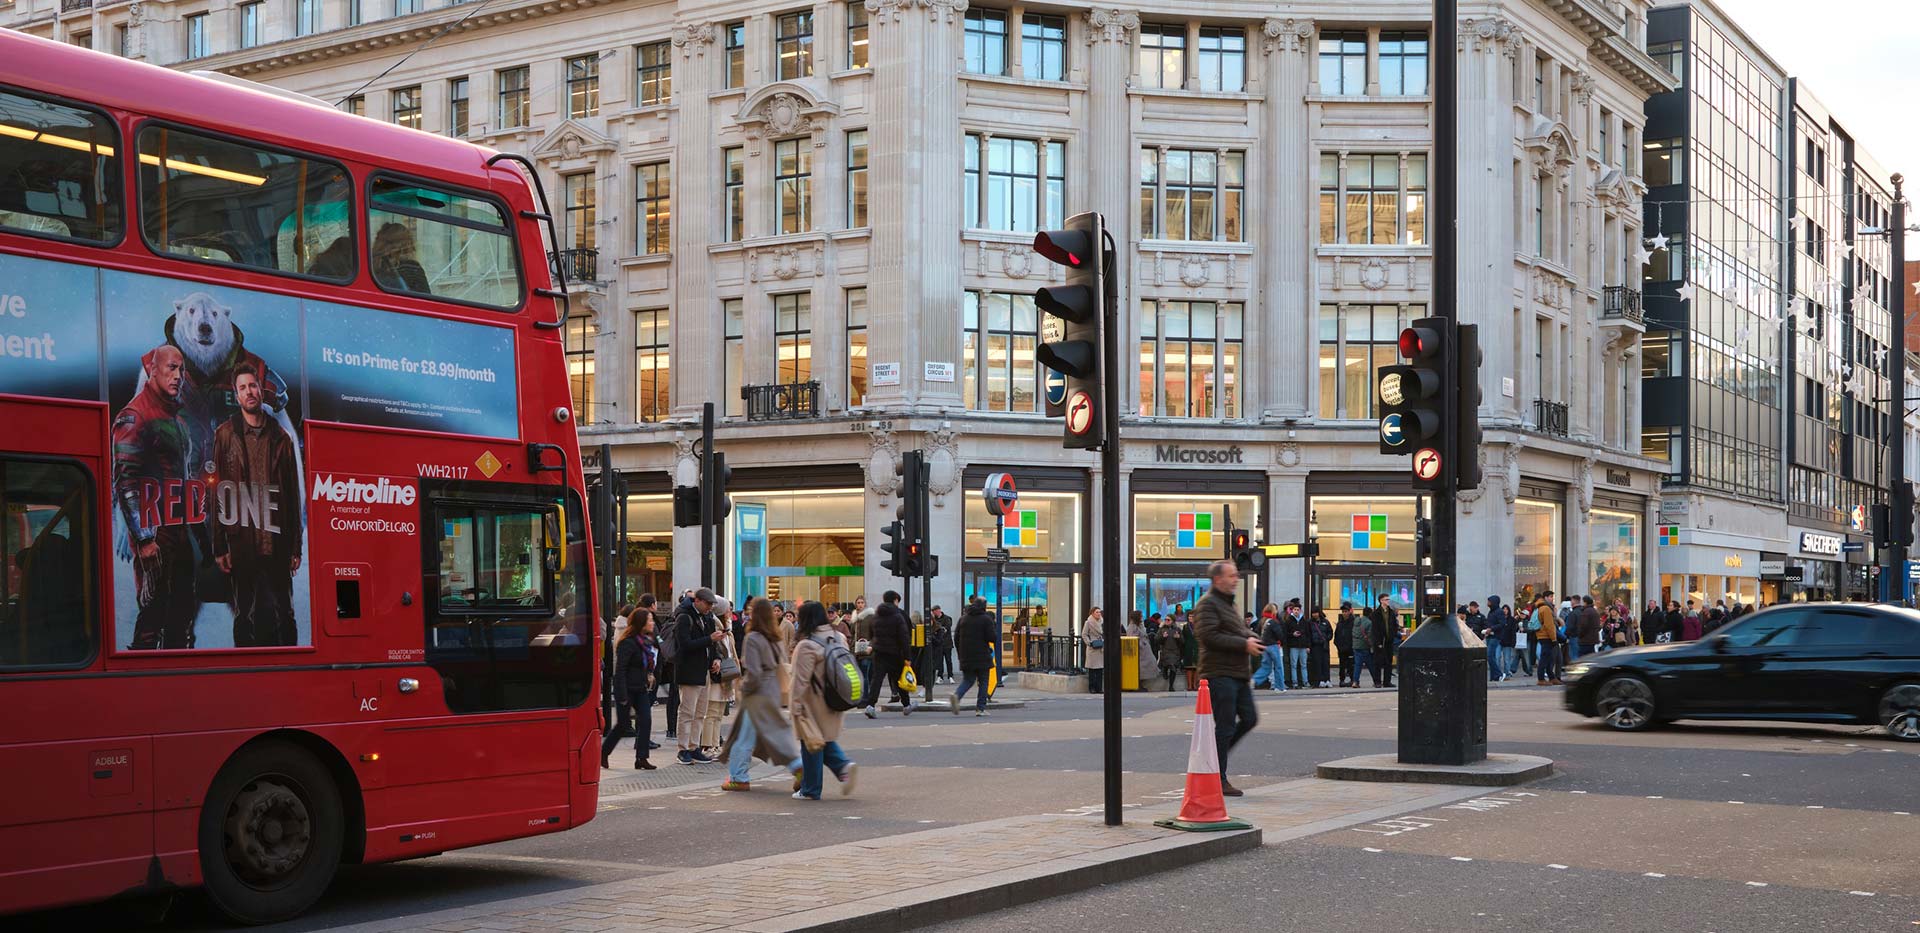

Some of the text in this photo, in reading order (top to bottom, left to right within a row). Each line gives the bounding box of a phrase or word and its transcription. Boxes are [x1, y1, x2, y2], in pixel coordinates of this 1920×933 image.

[345, 353, 361, 367] on
[362, 352, 399, 371] Prime
[400, 357, 420, 373] for
[421, 359, 496, 383] £8.99/month
[1156, 445, 1243, 463] Microsoft
[417, 463, 468, 479] VWH2117
[312, 473, 416, 506] Metroline
[140, 478, 281, 534] RED ONE
[336, 506, 362, 514] member
[363, 506, 371, 514] of
[1802, 533, 1841, 555] SKECHERS
[334, 567, 361, 577] DIESEL
[360, 697, 378, 711] AC
[95, 755, 128, 767] ADBLUE
[421, 832, 436, 840] PUSH
